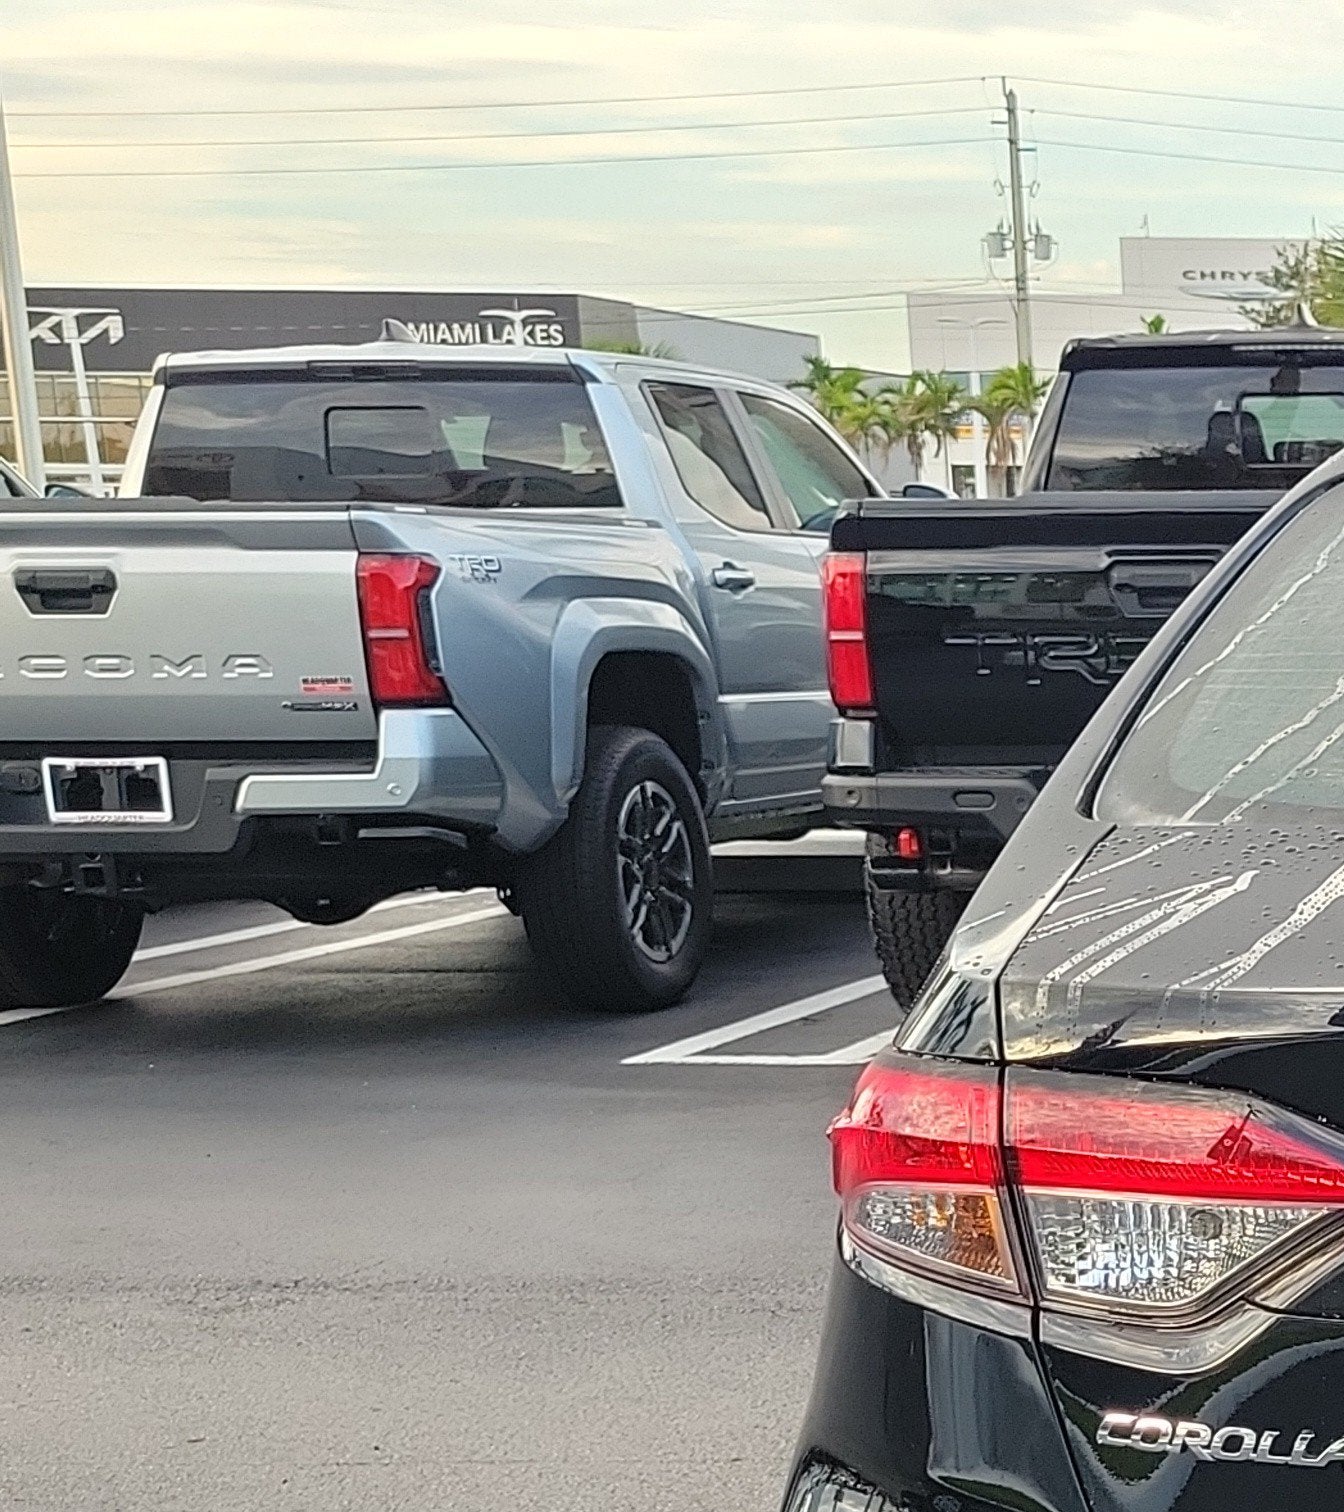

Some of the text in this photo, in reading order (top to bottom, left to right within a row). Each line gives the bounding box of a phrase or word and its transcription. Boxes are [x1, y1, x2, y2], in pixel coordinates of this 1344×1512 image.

[1182, 270, 1273, 281] CHRYS
[406, 322, 564, 346] MIAMI LAKES
[0, 654, 274, 679] COMA
